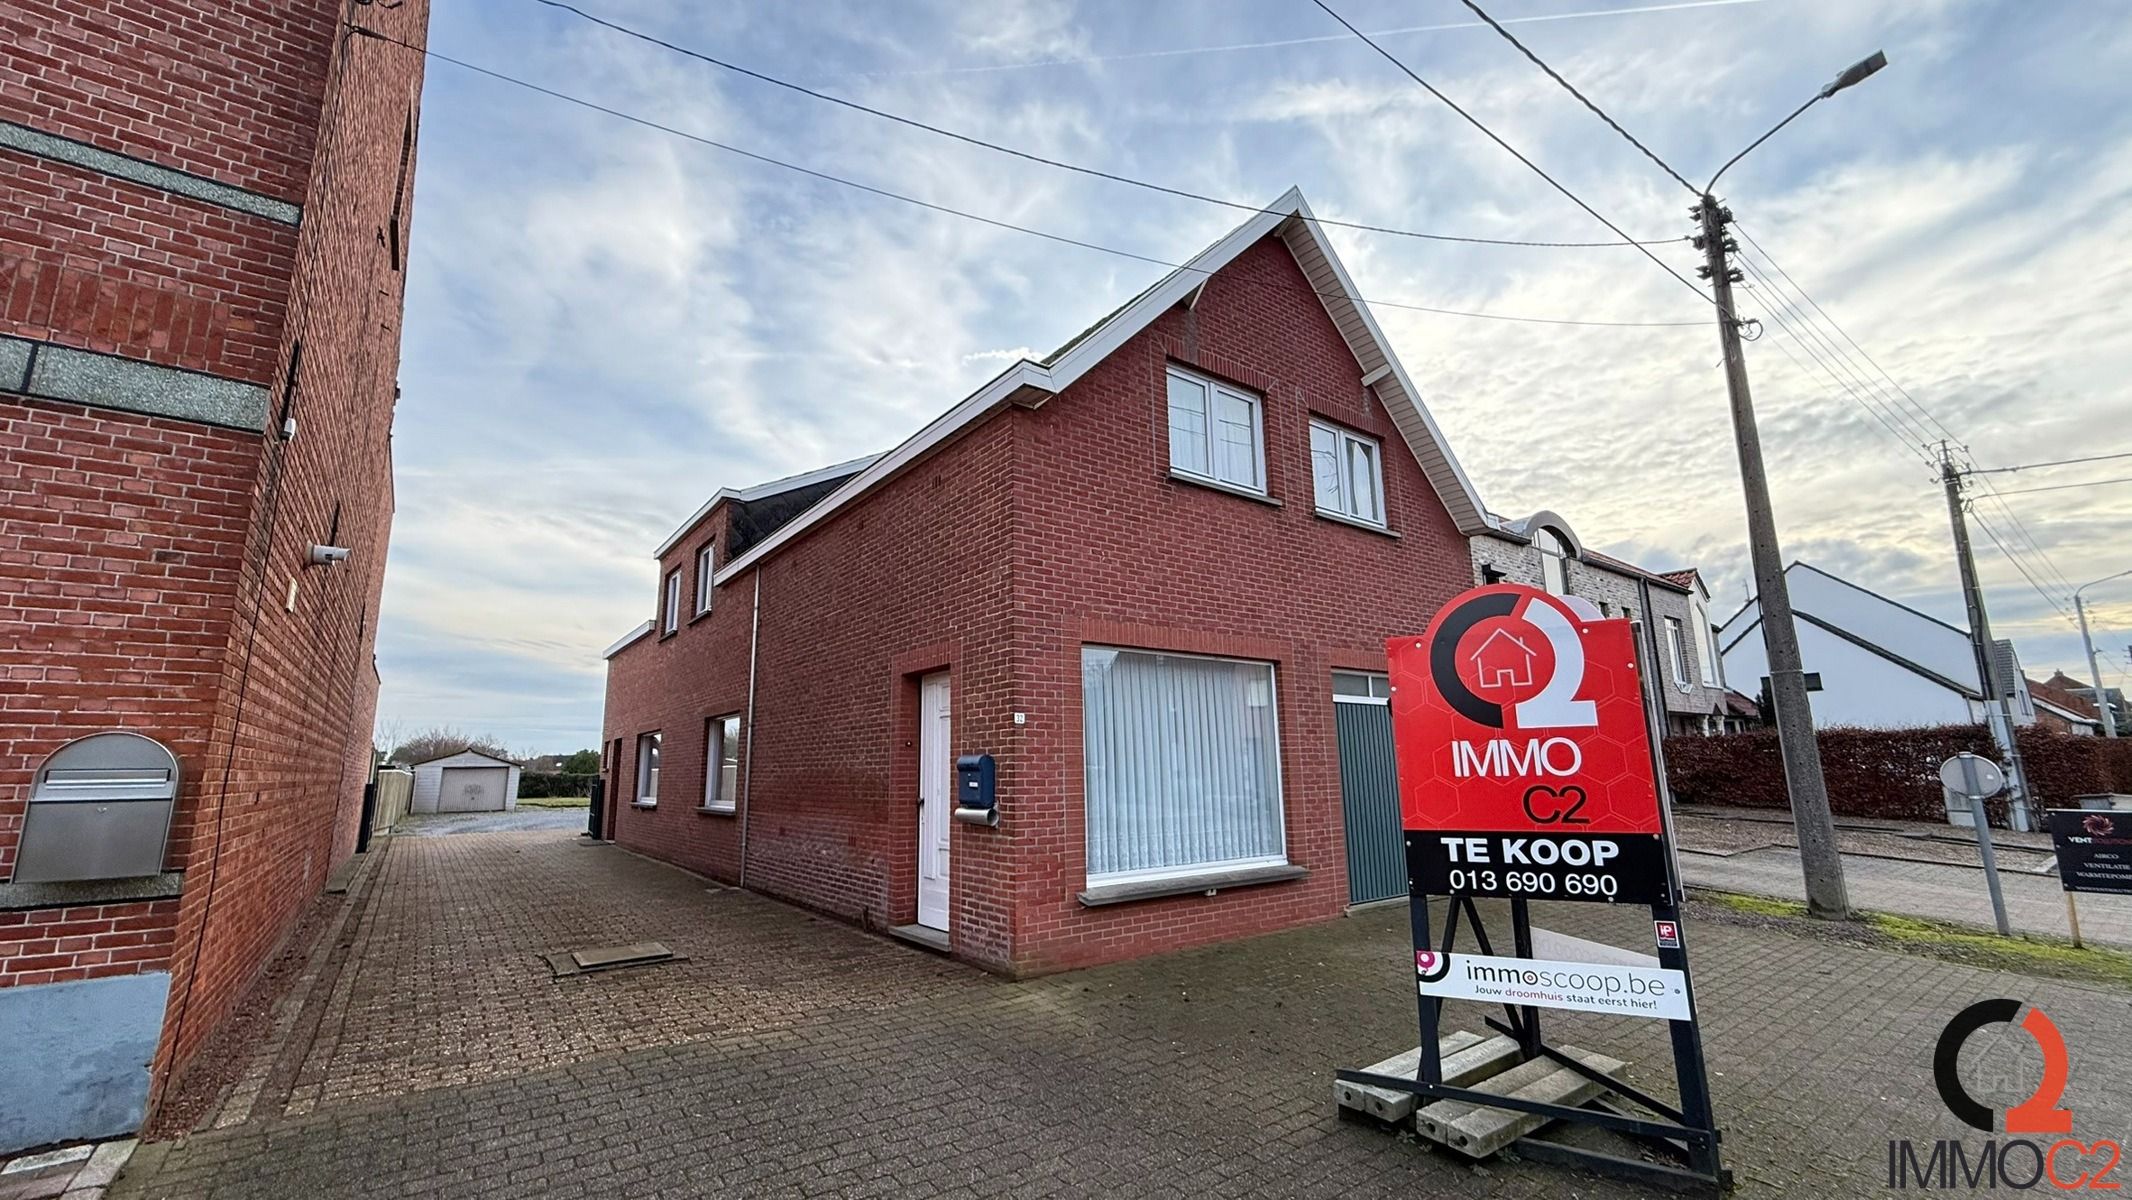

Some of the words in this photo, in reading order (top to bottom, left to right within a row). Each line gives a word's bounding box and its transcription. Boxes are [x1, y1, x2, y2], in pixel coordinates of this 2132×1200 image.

[1451, 736, 1583, 777] IMMO
[1522, 784, 1592, 825] C2
[1440, 837, 1491, 863] TE
[1501, 838, 1620, 867] KOOP
[1450, 869, 1498, 890] 013
[1505, 871, 1556, 893] 690
[1564, 873, 1618, 896] 690
[1466, 960, 1665, 997] immoscoop.be
[1475, 985, 1503, 996] Jouw
[1505, 987, 1563, 1001] droomhuis
[1566, 994, 1595, 1005] staat
[1599, 998, 1628, 1008] eerst
[1630, 999, 1658, 1010] hier!
